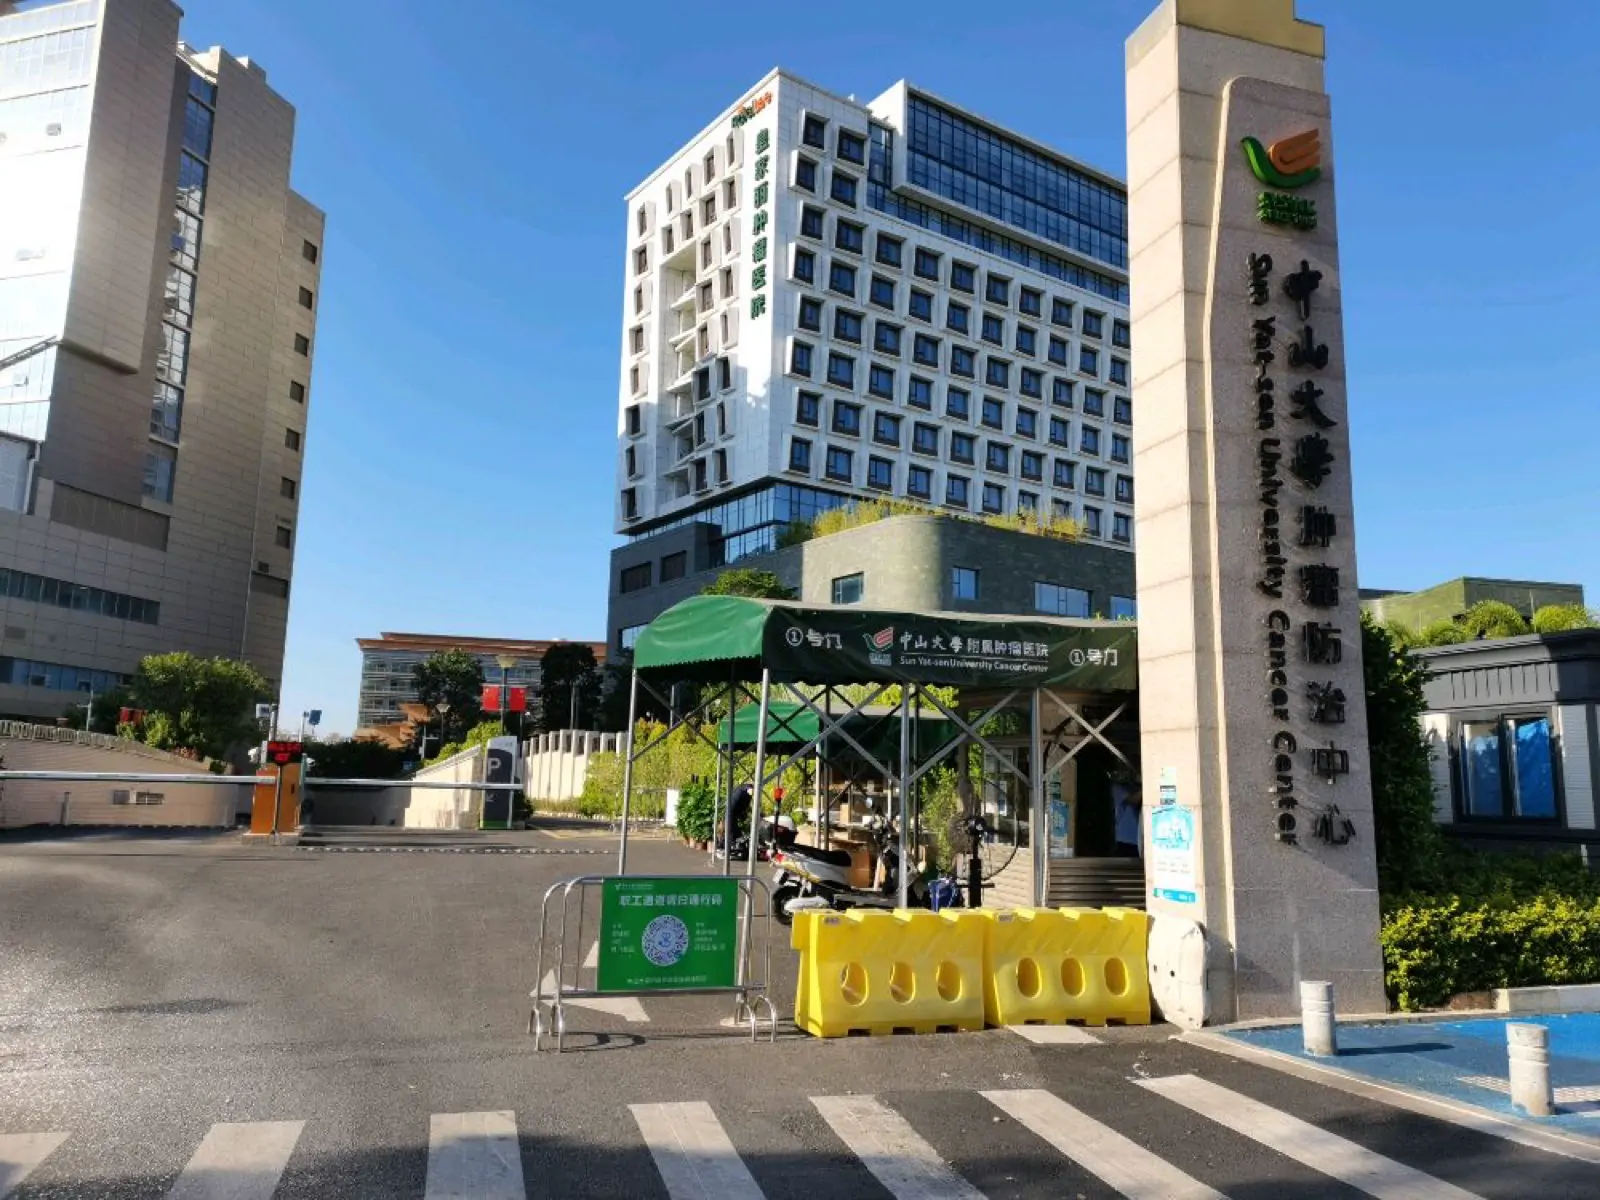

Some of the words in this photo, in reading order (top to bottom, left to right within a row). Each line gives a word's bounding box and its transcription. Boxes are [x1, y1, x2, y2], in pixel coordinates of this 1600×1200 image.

[1248, 252, 1273, 306] Sun
[1256, 437, 1288, 599] University
[900, 655, 916, 665] Sun
[918, 657, 950, 668] Yat-sen
[950, 658, 993, 671] University
[994, 661, 1022, 671] Cancer
[1022, 661, 1049, 673] Center
[1267, 609, 1291, 721] Cancer
[487, 757, 502, 776] P
[1273, 730, 1299, 846] Center
